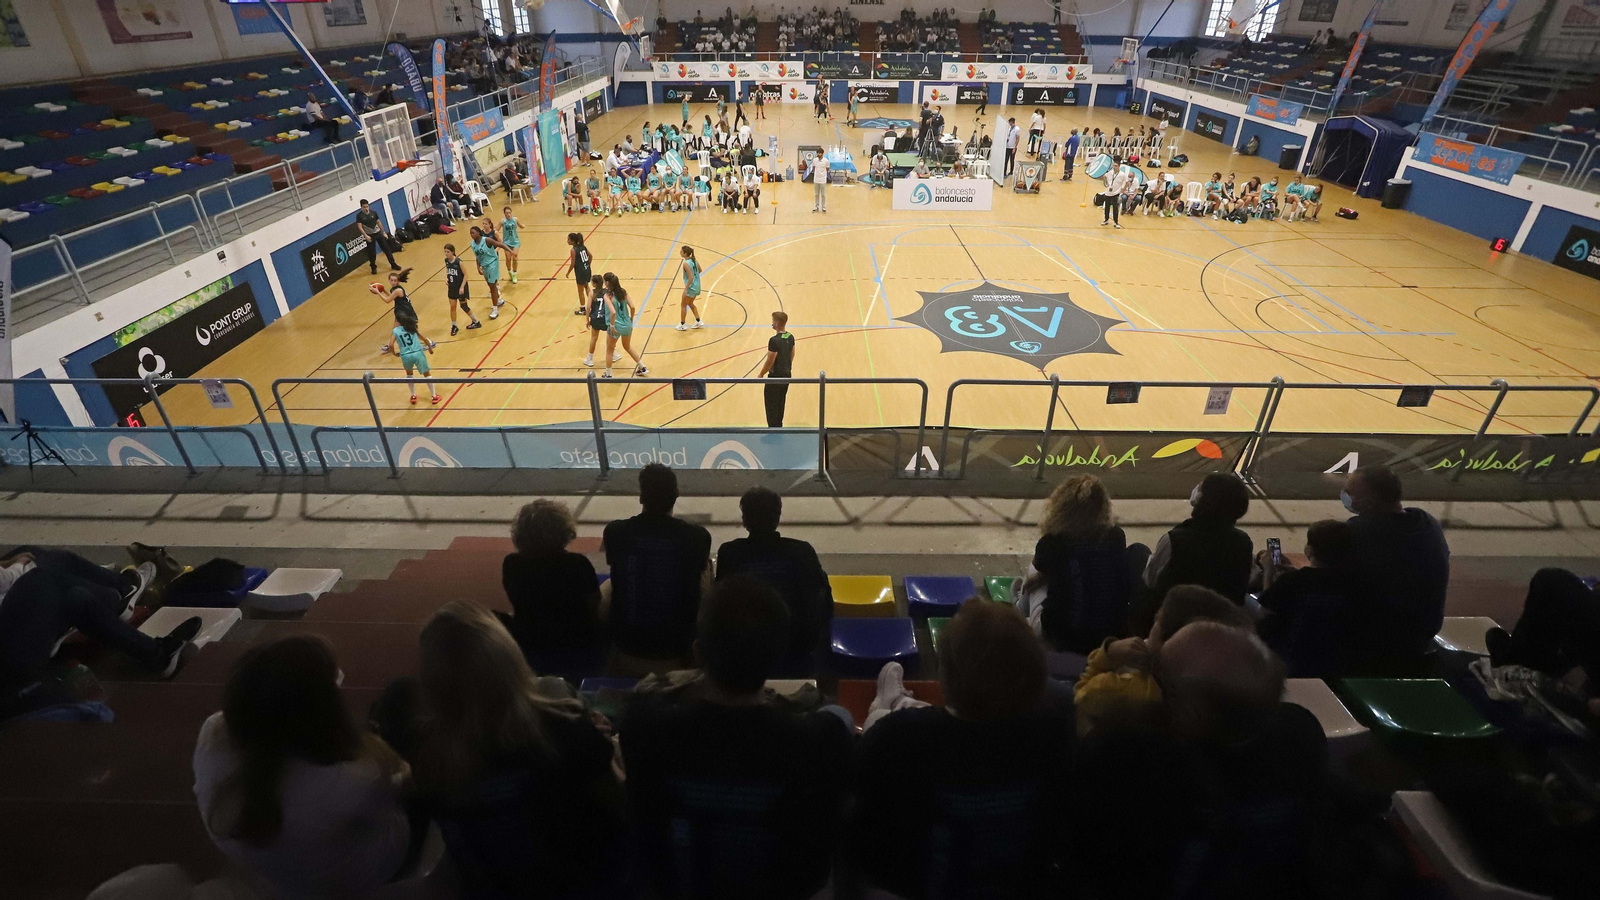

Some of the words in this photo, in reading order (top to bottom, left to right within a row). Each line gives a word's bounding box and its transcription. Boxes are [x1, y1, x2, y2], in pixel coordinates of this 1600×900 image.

[1131, 103, 1140, 111] 23
[1430, 141, 1498, 172] deportes
[935, 187, 976, 196] baloncesto
[935, 195, 973, 203] andalucía
[345, 234, 367, 250] baloncest
[1494, 239, 1506, 251] 6
[580, 250, 589, 263] 10
[450, 275, 454, 283] 9
[597, 298, 604, 310] 7
[209, 314, 232, 334] PONT
[231, 302, 252, 320] GRUP
[399, 333, 413, 348] 13
